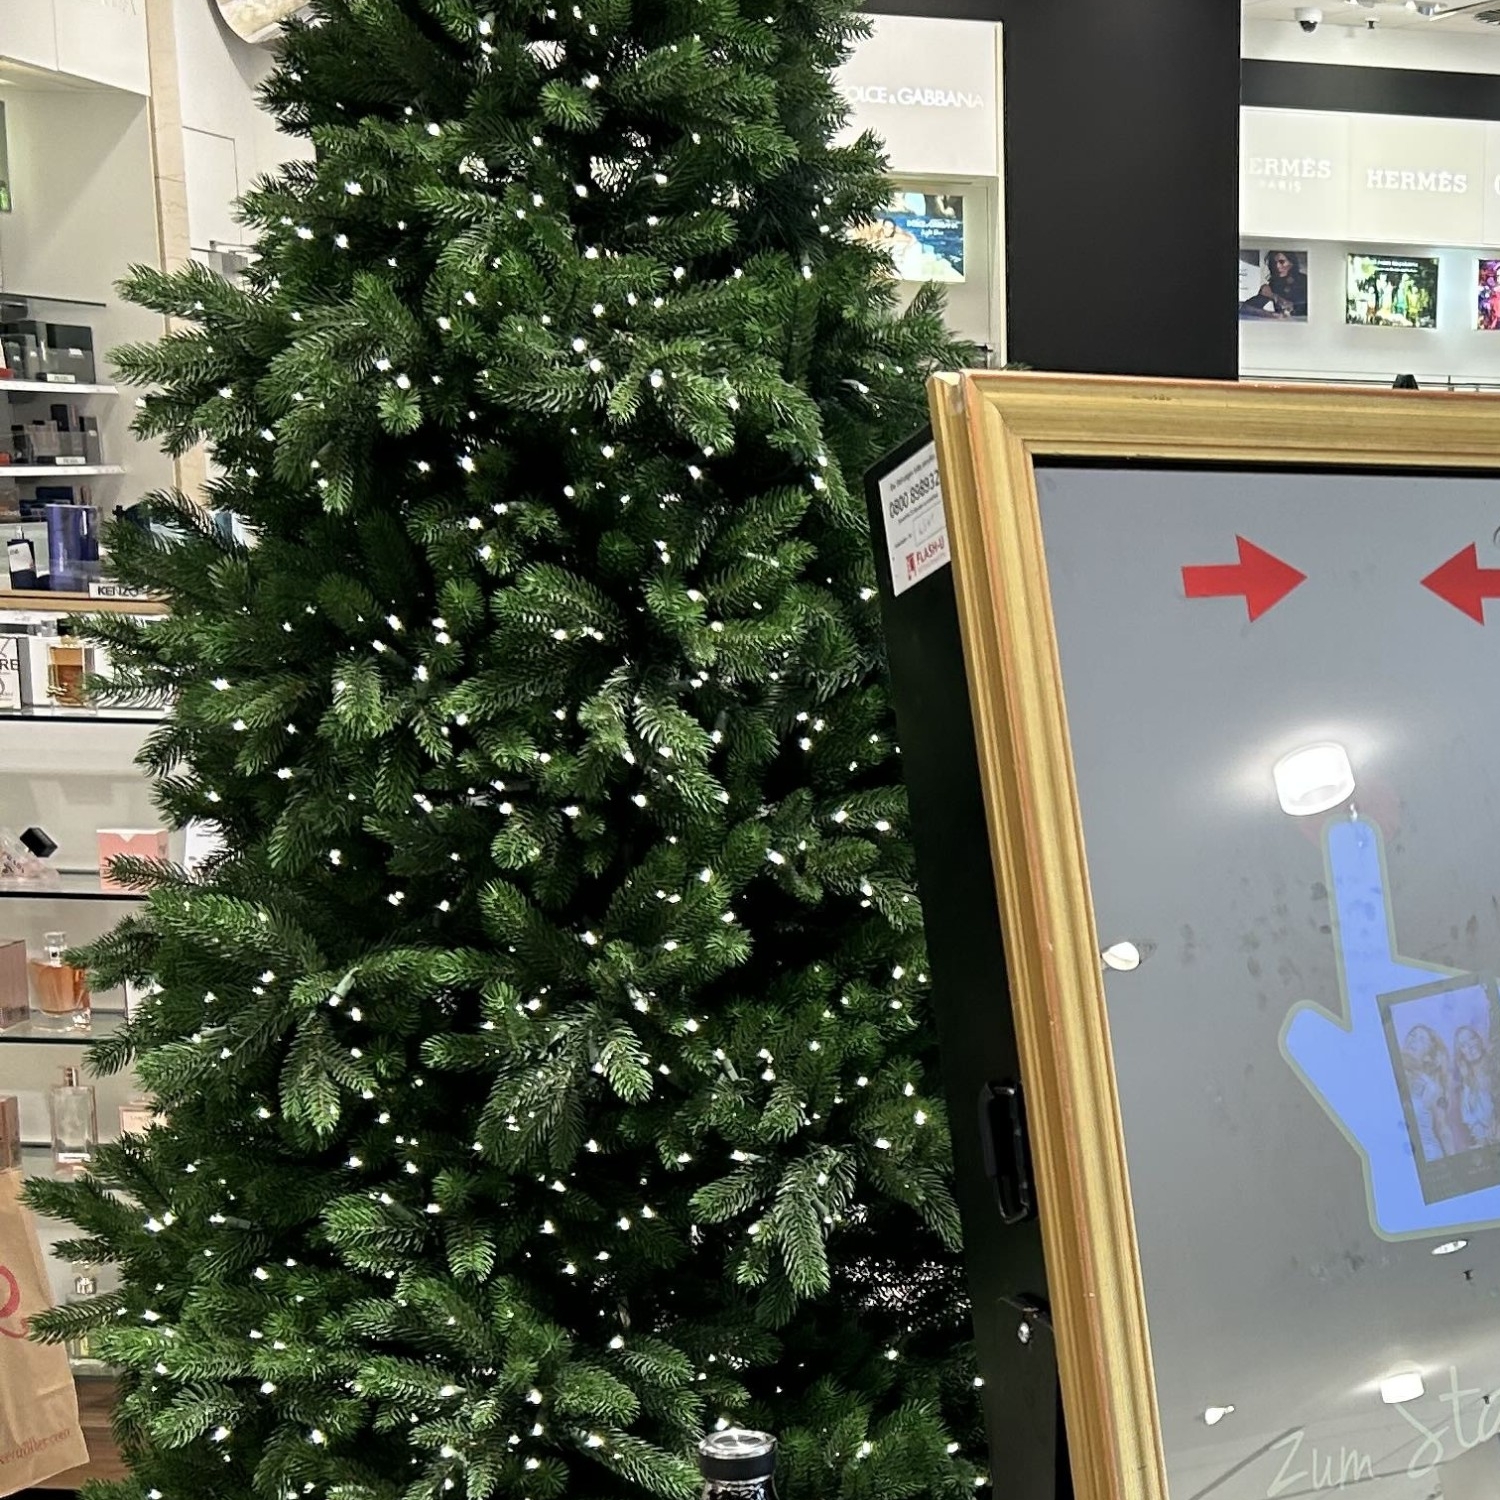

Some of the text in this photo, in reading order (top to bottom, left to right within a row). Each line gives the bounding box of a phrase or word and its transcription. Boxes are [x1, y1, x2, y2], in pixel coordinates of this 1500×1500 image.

[1247, 155, 1332, 179] ERMÈS
[1366, 168, 1468, 194] HERMÈS
[97, 585, 139, 597] KENZO
[1266, 1431, 1376, 1498] Zum
